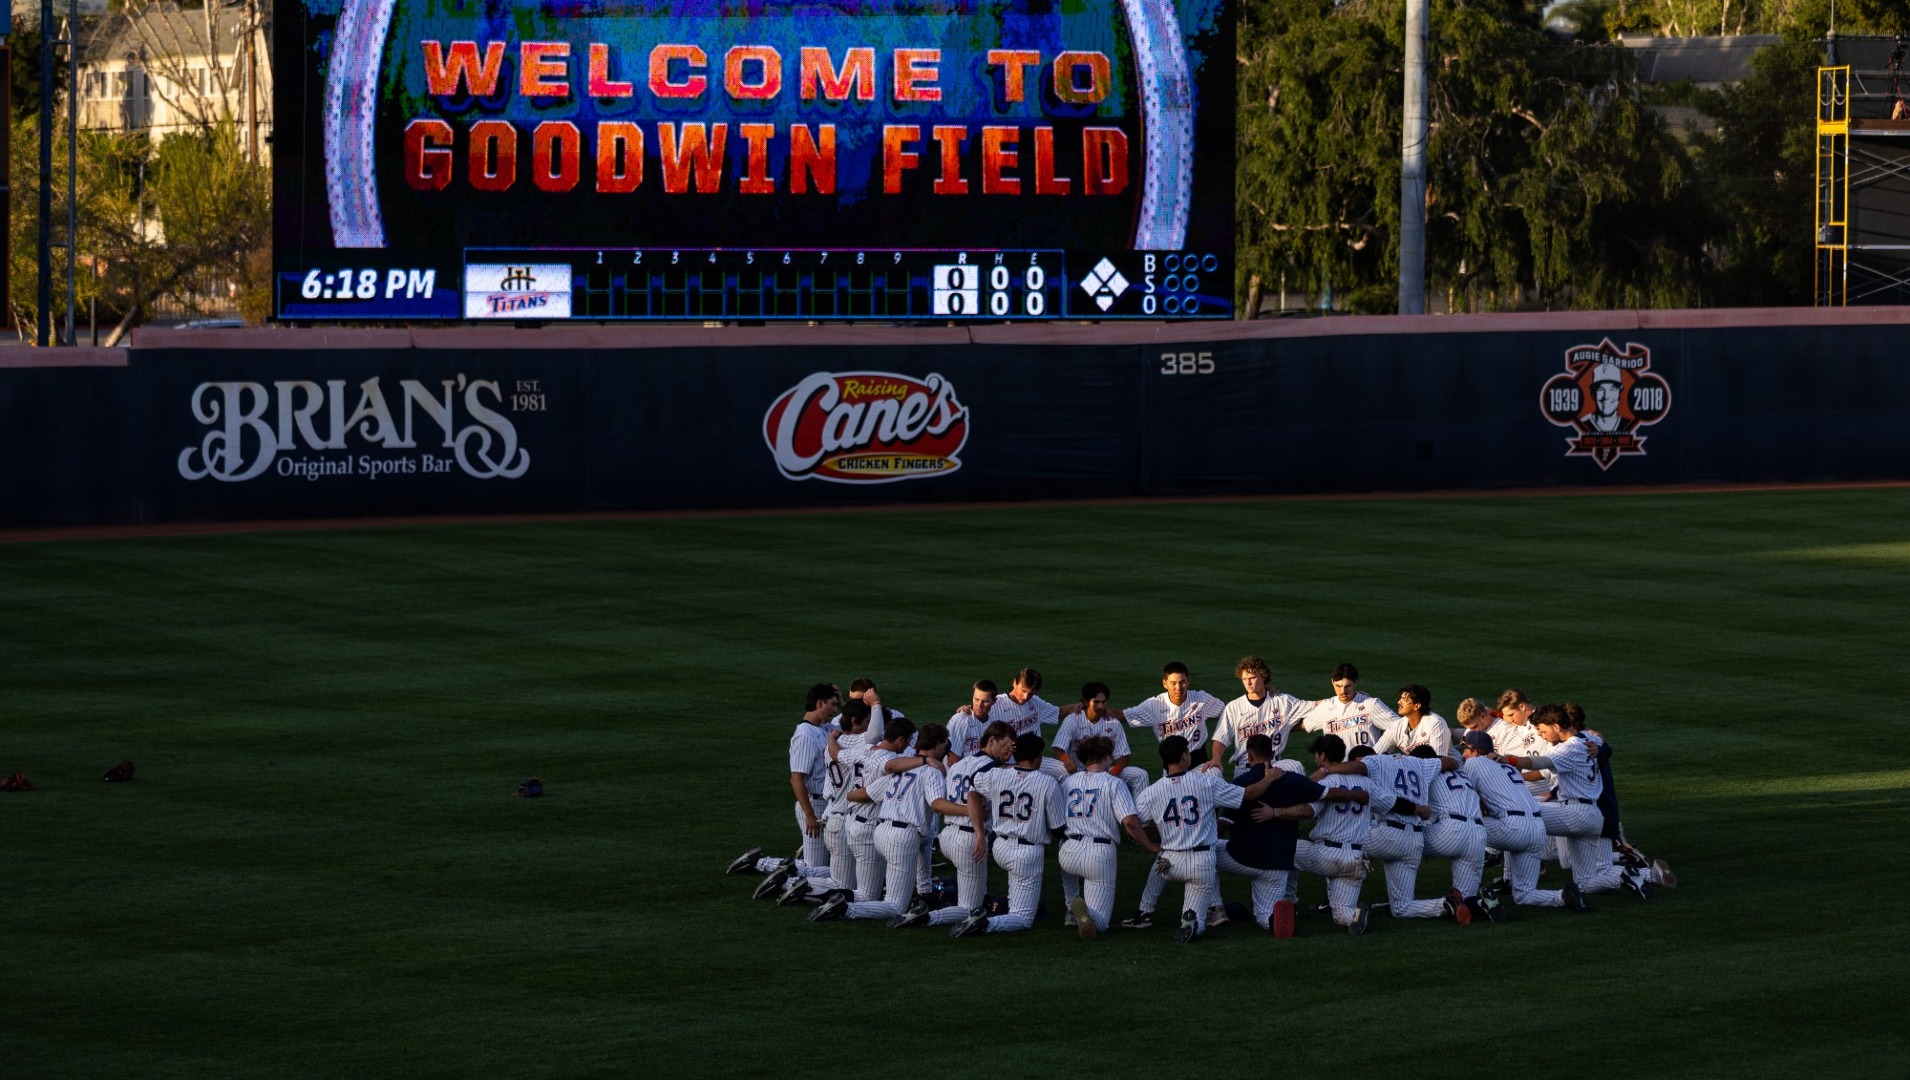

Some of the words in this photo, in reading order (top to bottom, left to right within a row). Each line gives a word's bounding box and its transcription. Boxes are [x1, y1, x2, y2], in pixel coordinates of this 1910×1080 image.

[421, 41, 942, 101] WELCOME
[987, 49, 1112, 104] TO
[403, 119, 836, 195] GOODWIN
[883, 124, 1129, 196] FIELD
[596, 250, 604, 265] 1
[633, 250, 643, 265] 2
[671, 250, 680, 265] 3
[708, 251, 717, 264] 4
[746, 251, 755, 265] 5
[782, 251, 791, 265] 6
[820, 251, 829, 265] 7
[856, 251, 866, 265] 8
[893, 251, 902, 265] 9
[958, 252, 968, 265] R
[994, 253, 1004, 265] H
[1030, 252, 1039, 265] E
[1144, 253, 1156, 273] B
[301, 269, 375, 300] 6:18
[385, 269, 436, 300] PM
[947, 267, 965, 289] 0
[991, 265, 1009, 290] 0
[1026, 265, 1044, 290] 0
[1144, 274, 1155, 294] S
[947, 292, 965, 314] 0
[991, 291, 1009, 316] 0
[1026, 291, 1044, 316] 0
[1160, 352, 1216, 375] 385
[1573, 350, 1600, 363] AUGIE
[1602, 352, 1644, 369] GARRIDO
[516, 380, 541, 392] EST.
[842, 379, 908, 400] Raising
[511, 394, 547, 412] 1981
[1550, 388, 1579, 412] 1939
[1633, 387, 1663, 411] 2018
[178, 373, 530, 482] BRIAN'S
[775, 373, 963, 471] Cane's
[277, 454, 353, 481] Original
[358, 454, 416, 480] Sports
[422, 453, 453, 473] Bar
[838, 457, 891, 470] CHICKEN
[894, 457, 945, 470] FINGERS
[1355, 731, 1369, 745] 10
[886, 772, 917, 800] 37
[1394, 768, 1420, 798] 49
[999, 790, 1034, 822] 23
[1068, 788, 1101, 818] 27
[1163, 795, 1199, 828] 43
